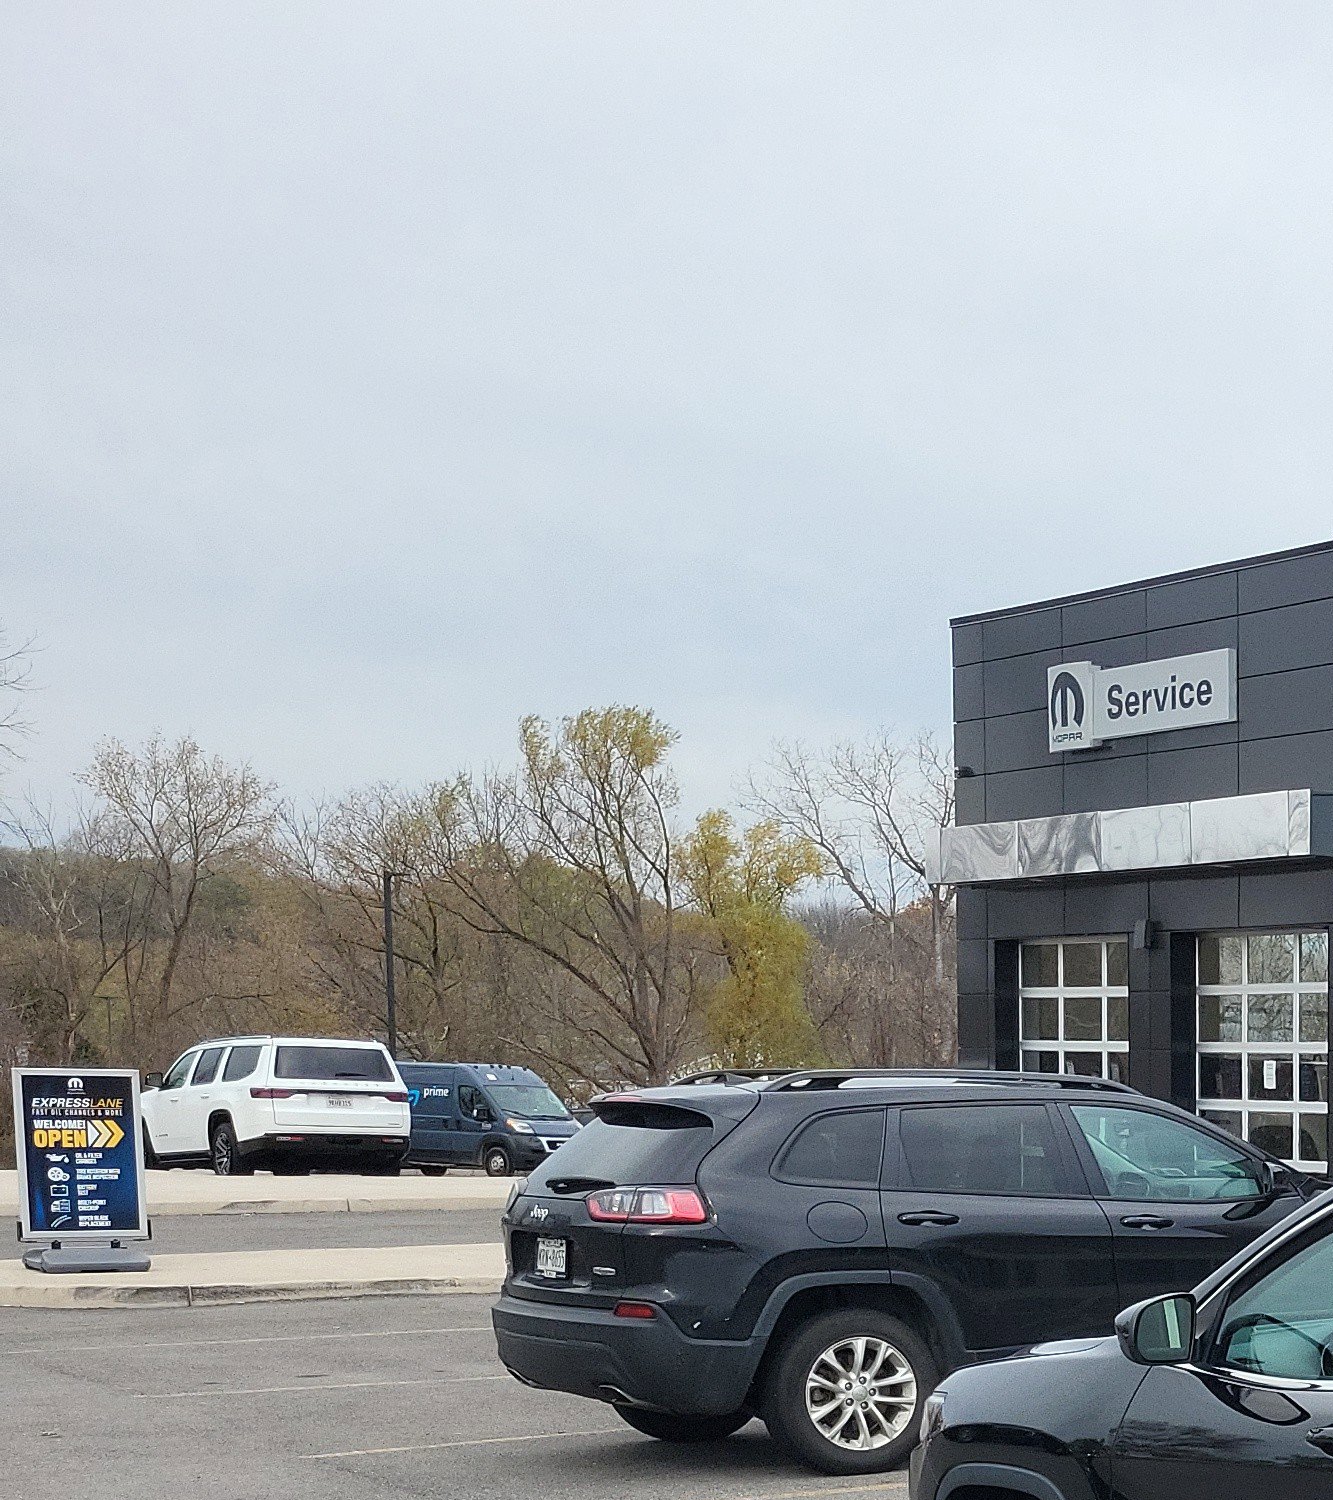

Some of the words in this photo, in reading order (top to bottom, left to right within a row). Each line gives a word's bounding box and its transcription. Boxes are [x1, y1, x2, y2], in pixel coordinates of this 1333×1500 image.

[1107, 675, 1213, 719] Service
[423, 1086, 450, 1098] prime
[33, 1129, 87, 1148] OPEN
